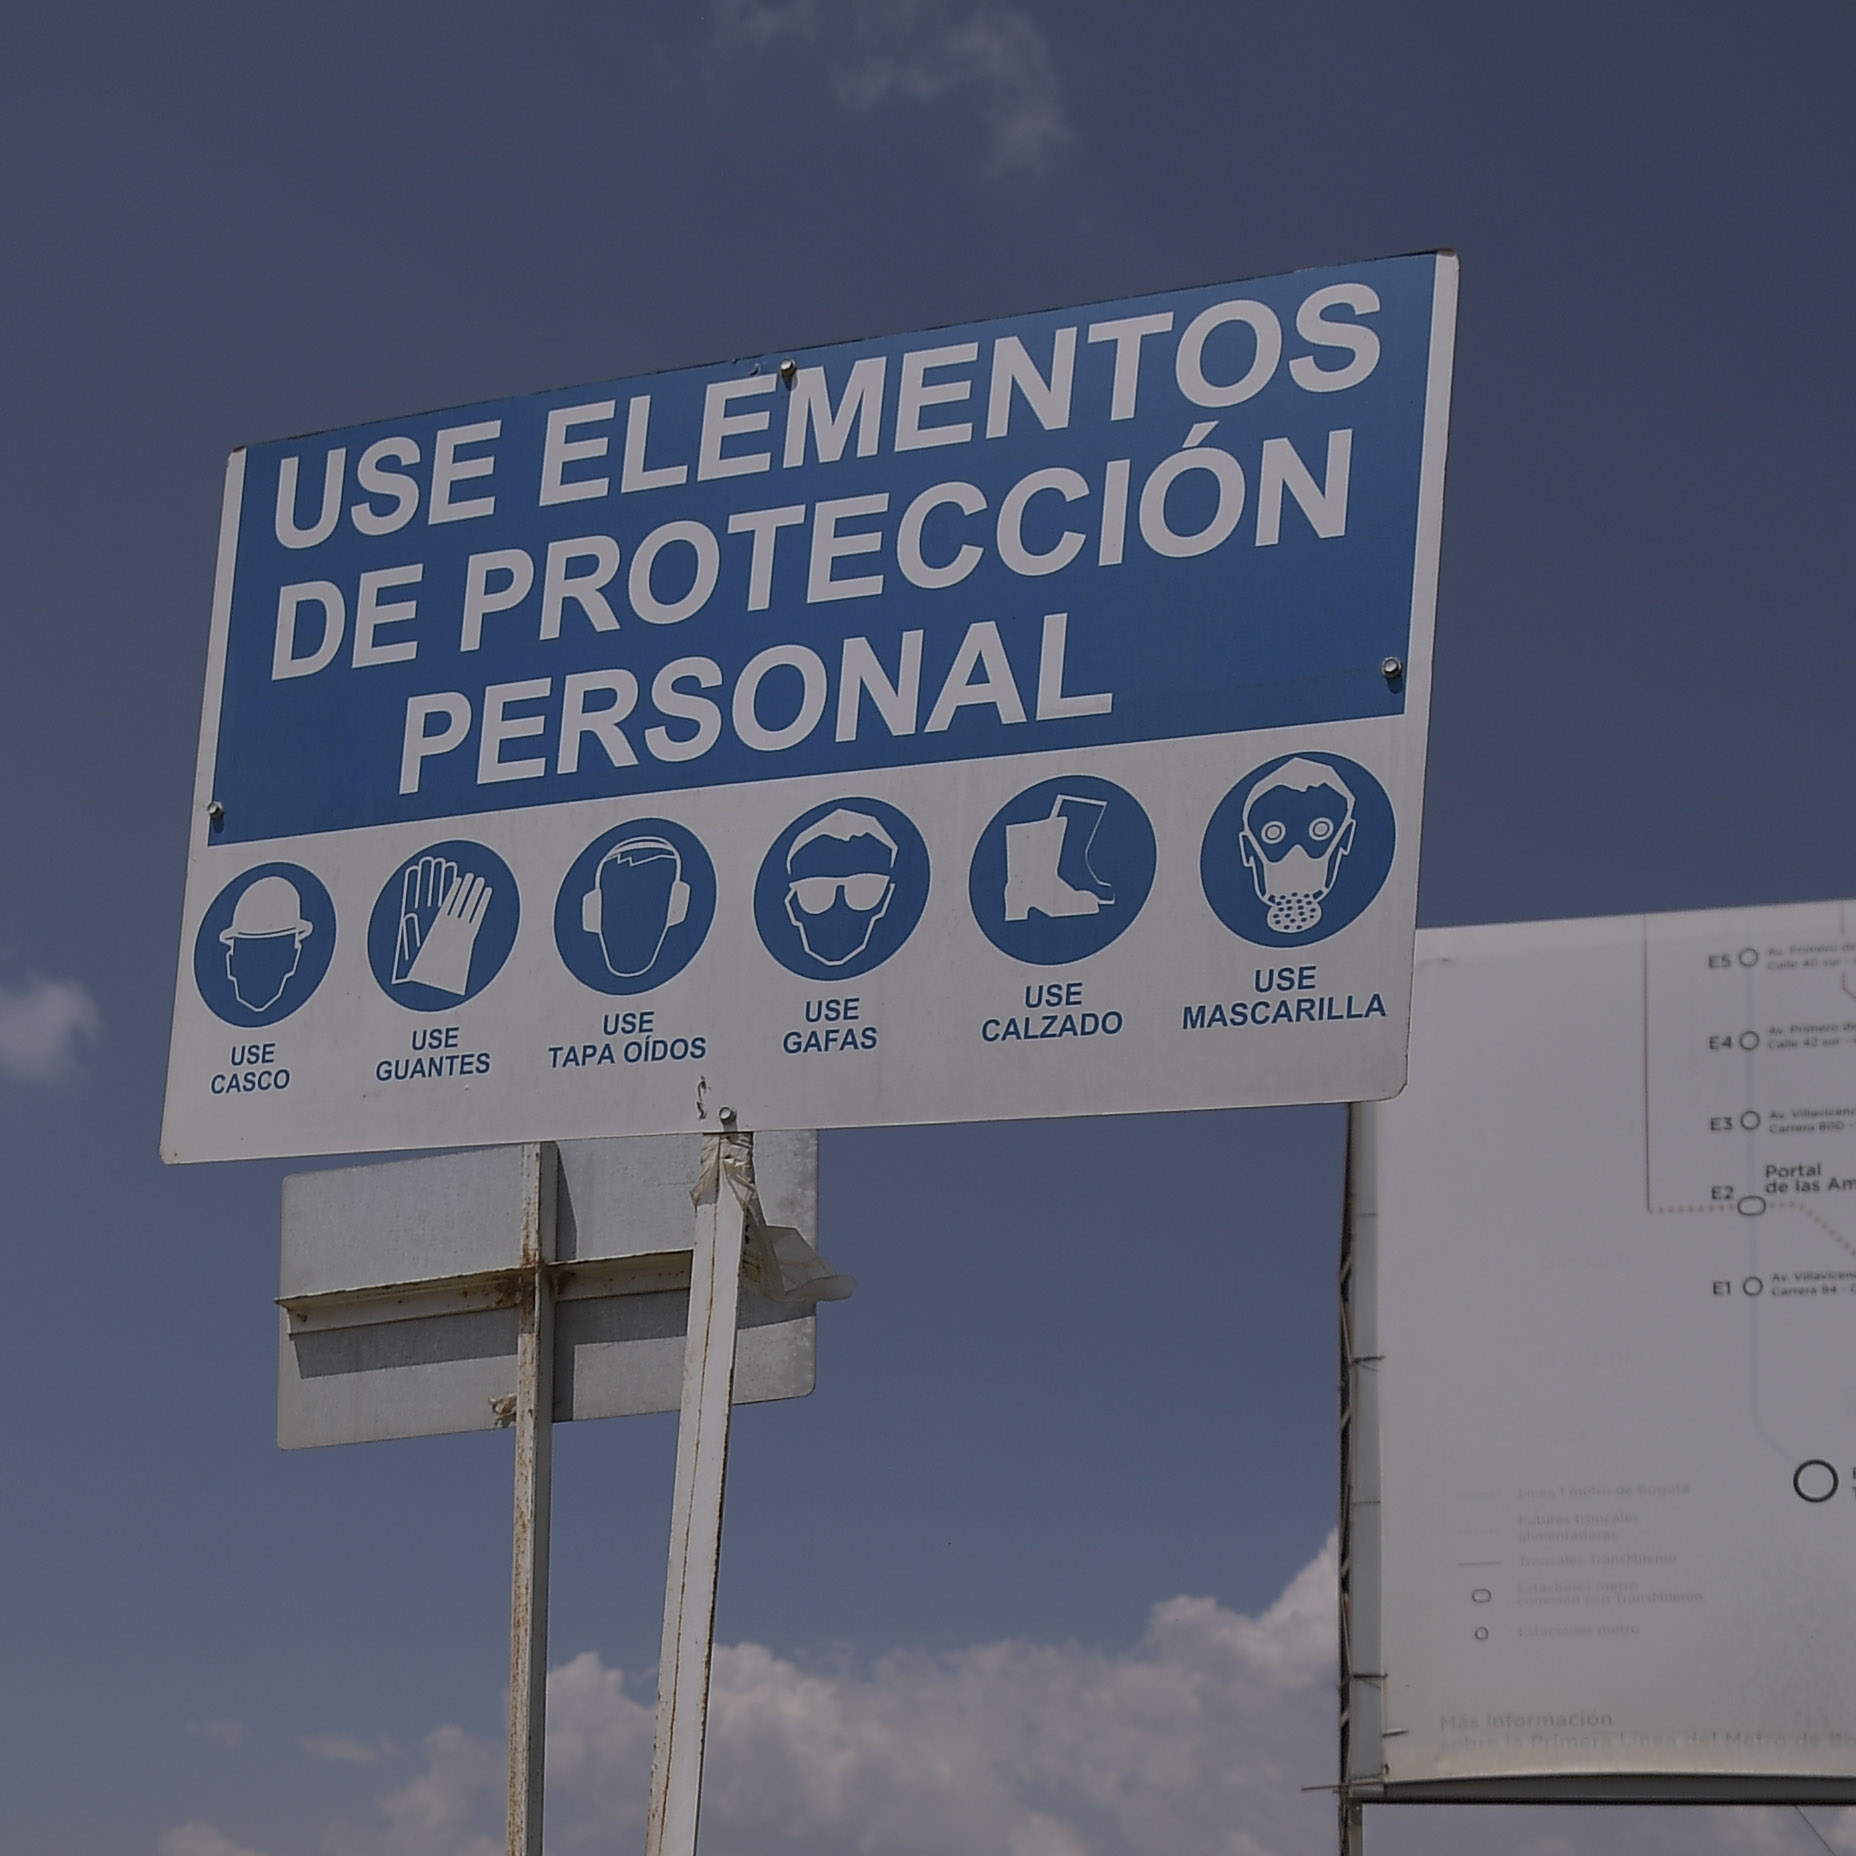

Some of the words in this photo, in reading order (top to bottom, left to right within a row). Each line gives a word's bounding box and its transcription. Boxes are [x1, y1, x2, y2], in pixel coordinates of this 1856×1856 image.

[275, 420, 504, 548] USE
[538, 282, 1382, 507] ELEMENTOS
[271, 562, 426, 680] DE
[460, 422, 1354, 652] PROTECCIÓN
[399, 612, 1114, 795] PERSONAL
[1708, 955, 1731, 968] E5
[1253, 965, 1317, 993] USE
[1023, 982, 1084, 1009] USE
[803, 996, 861, 1023] USE
[1181, 993, 1388, 1031] MASCARILLA
[602, 1011, 656, 1037] USE
[980, 1010, 1124, 1043] CALZADO
[410, 1027, 460, 1052] USE
[548, 1043, 616, 1070] TAPA
[622, 1036, 708, 1063] OÍDOS
[782, 1026, 879, 1055] GAFAS
[1708, 1036, 1733, 1050] E4
[229, 1043, 277, 1067] USE
[374, 1052, 492, 1083] GUANTES
[209, 1068, 291, 1095] CASCO
[1710, 1117, 1733, 1132] E3
[1765, 1162, 1822, 1179] Portal
[1711, 1185, 1735, 1200] E2
[1765, 1180, 1789, 1194] de
[1796, 1179, 1820, 1193] las
[1712, 1280, 1732, 1296] E1
